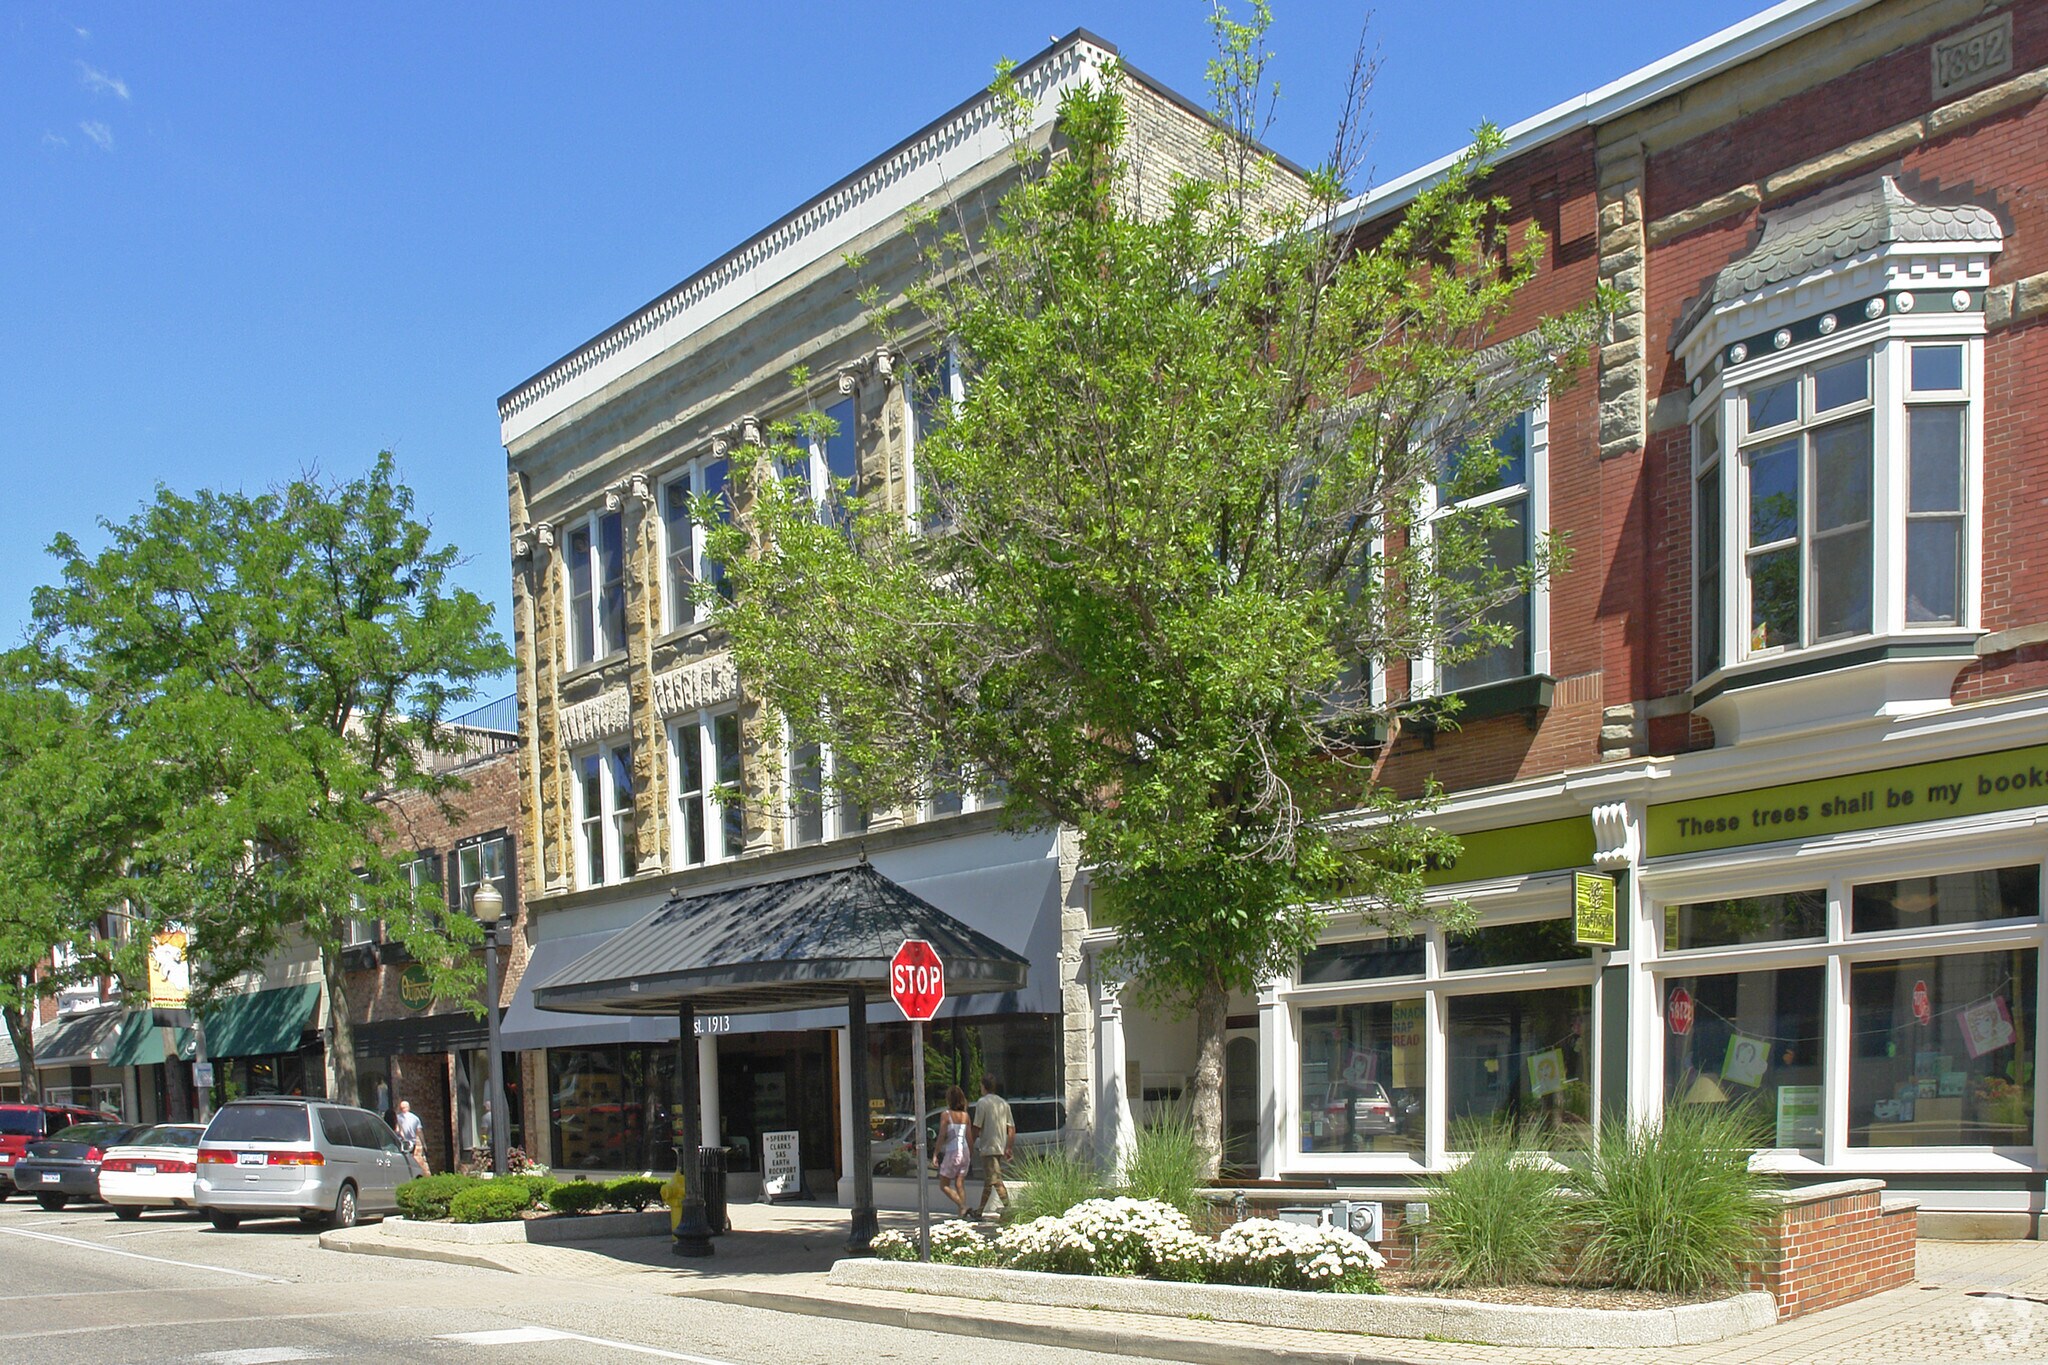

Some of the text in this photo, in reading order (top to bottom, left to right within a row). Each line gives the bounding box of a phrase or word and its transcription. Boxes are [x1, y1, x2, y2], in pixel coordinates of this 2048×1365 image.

[1940, 28, 2007, 83] 1892
[1677, 766, 2048, 838] These trees shall be my book
[402, 975, 433, 1006] Outpos
[894, 964, 941, 995] STOP
[694, 1015, 730, 1034] st. 1913
[1393, 1034, 1420, 1047] READ
